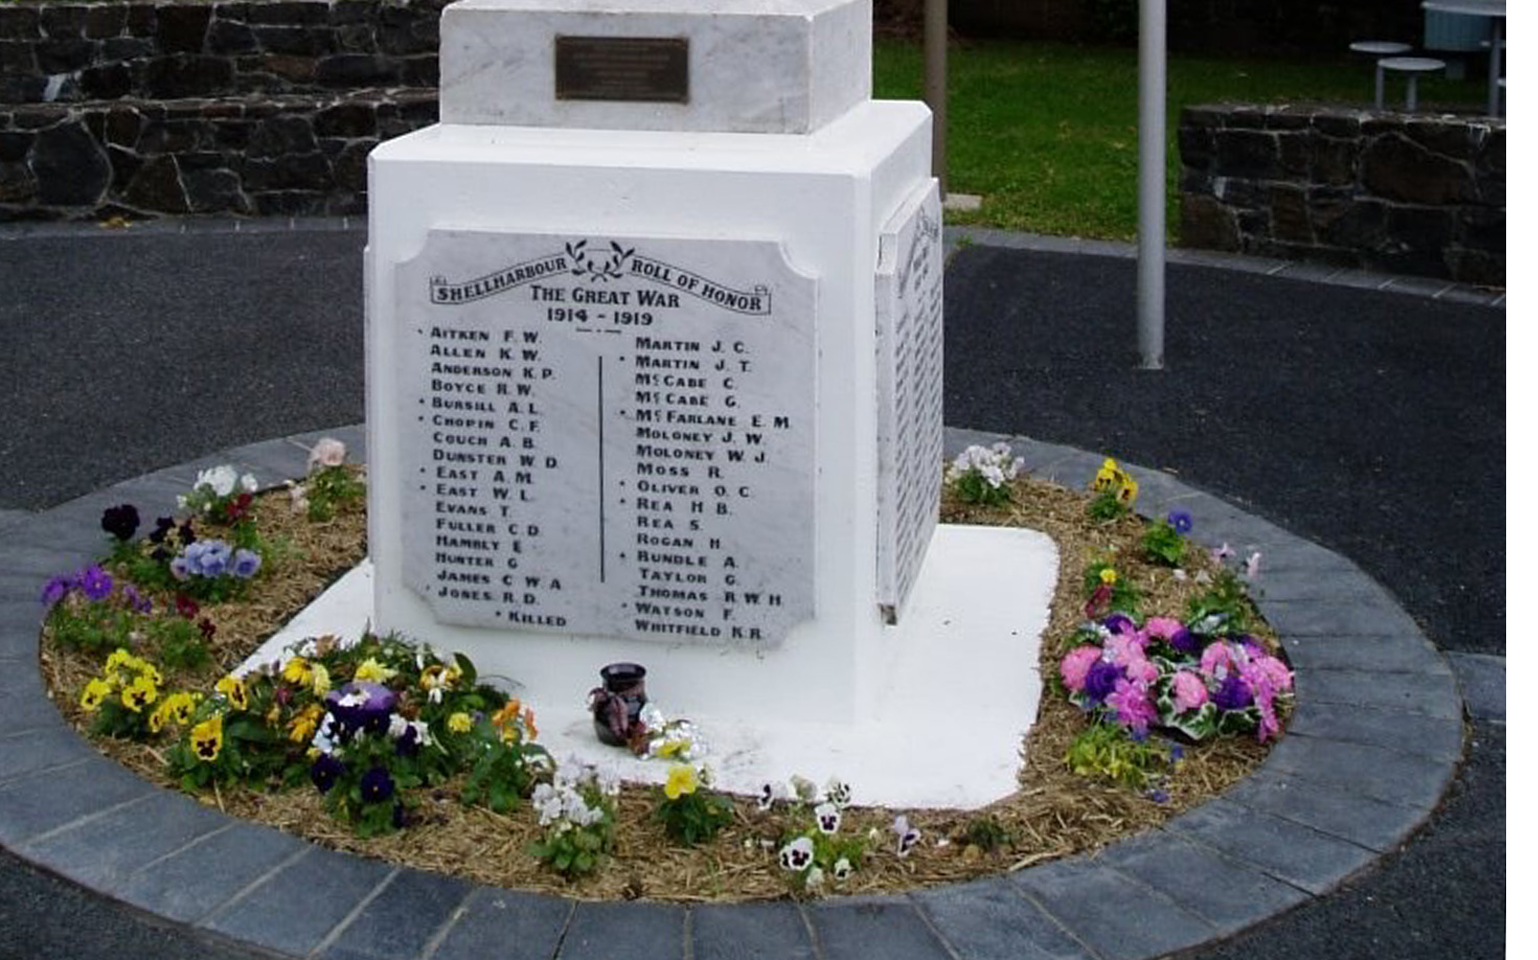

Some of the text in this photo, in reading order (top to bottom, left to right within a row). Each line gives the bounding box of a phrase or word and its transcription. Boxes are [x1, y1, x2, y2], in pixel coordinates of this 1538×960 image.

[434, 258, 761, 311] SHELLHARBOUR ROLL OF HONOR
[531, 286, 679, 308] THE GREAT WAR
[548, 308, 652, 325] 1914 1919
[431, 327, 489, 341] AITKEN
[430, 344, 485, 358] ALLEN
[636, 337, 699, 351] MARTIN
[432, 362, 511, 377] ANDERSON
[636, 355, 699, 369] MARTIN
[432, 379, 484, 394] BOYCE
[432, 397, 495, 412] BURSILL
[432, 415, 494, 429] CHOPIN
[433, 432, 487, 446] COUCH
[636, 427, 712, 442] MOLONEY
[433, 449, 506, 465] DUNSTER
[636, 444, 713, 460] MOLONEY
[437, 466, 477, 480] EAST
[637, 462, 689, 477] MOSS
[437, 484, 477, 497] EAST
[638, 480, 699, 494] OLIVER
[436, 501, 487, 515] EVANS
[637, 498, 672, 511] REA
[436, 518, 495, 534] FULLER
[637, 516, 673, 529] REA
[436, 535, 499, 550] HAMBLY
[637, 533, 693, 547] ROGAN
[436, 552, 493, 567] HUNTER
[638, 550, 706, 567] RUNDLE
[437, 570, 490, 584] JAMES
[640, 568, 706, 583] TAYLOR
[439, 587, 492, 600] JONES
[639, 585, 707, 601] THOMAS
[635, 602, 704, 618] WATSON
[509, 612, 566, 626] KILLED
[635, 619, 721, 636] WHITFIELD
